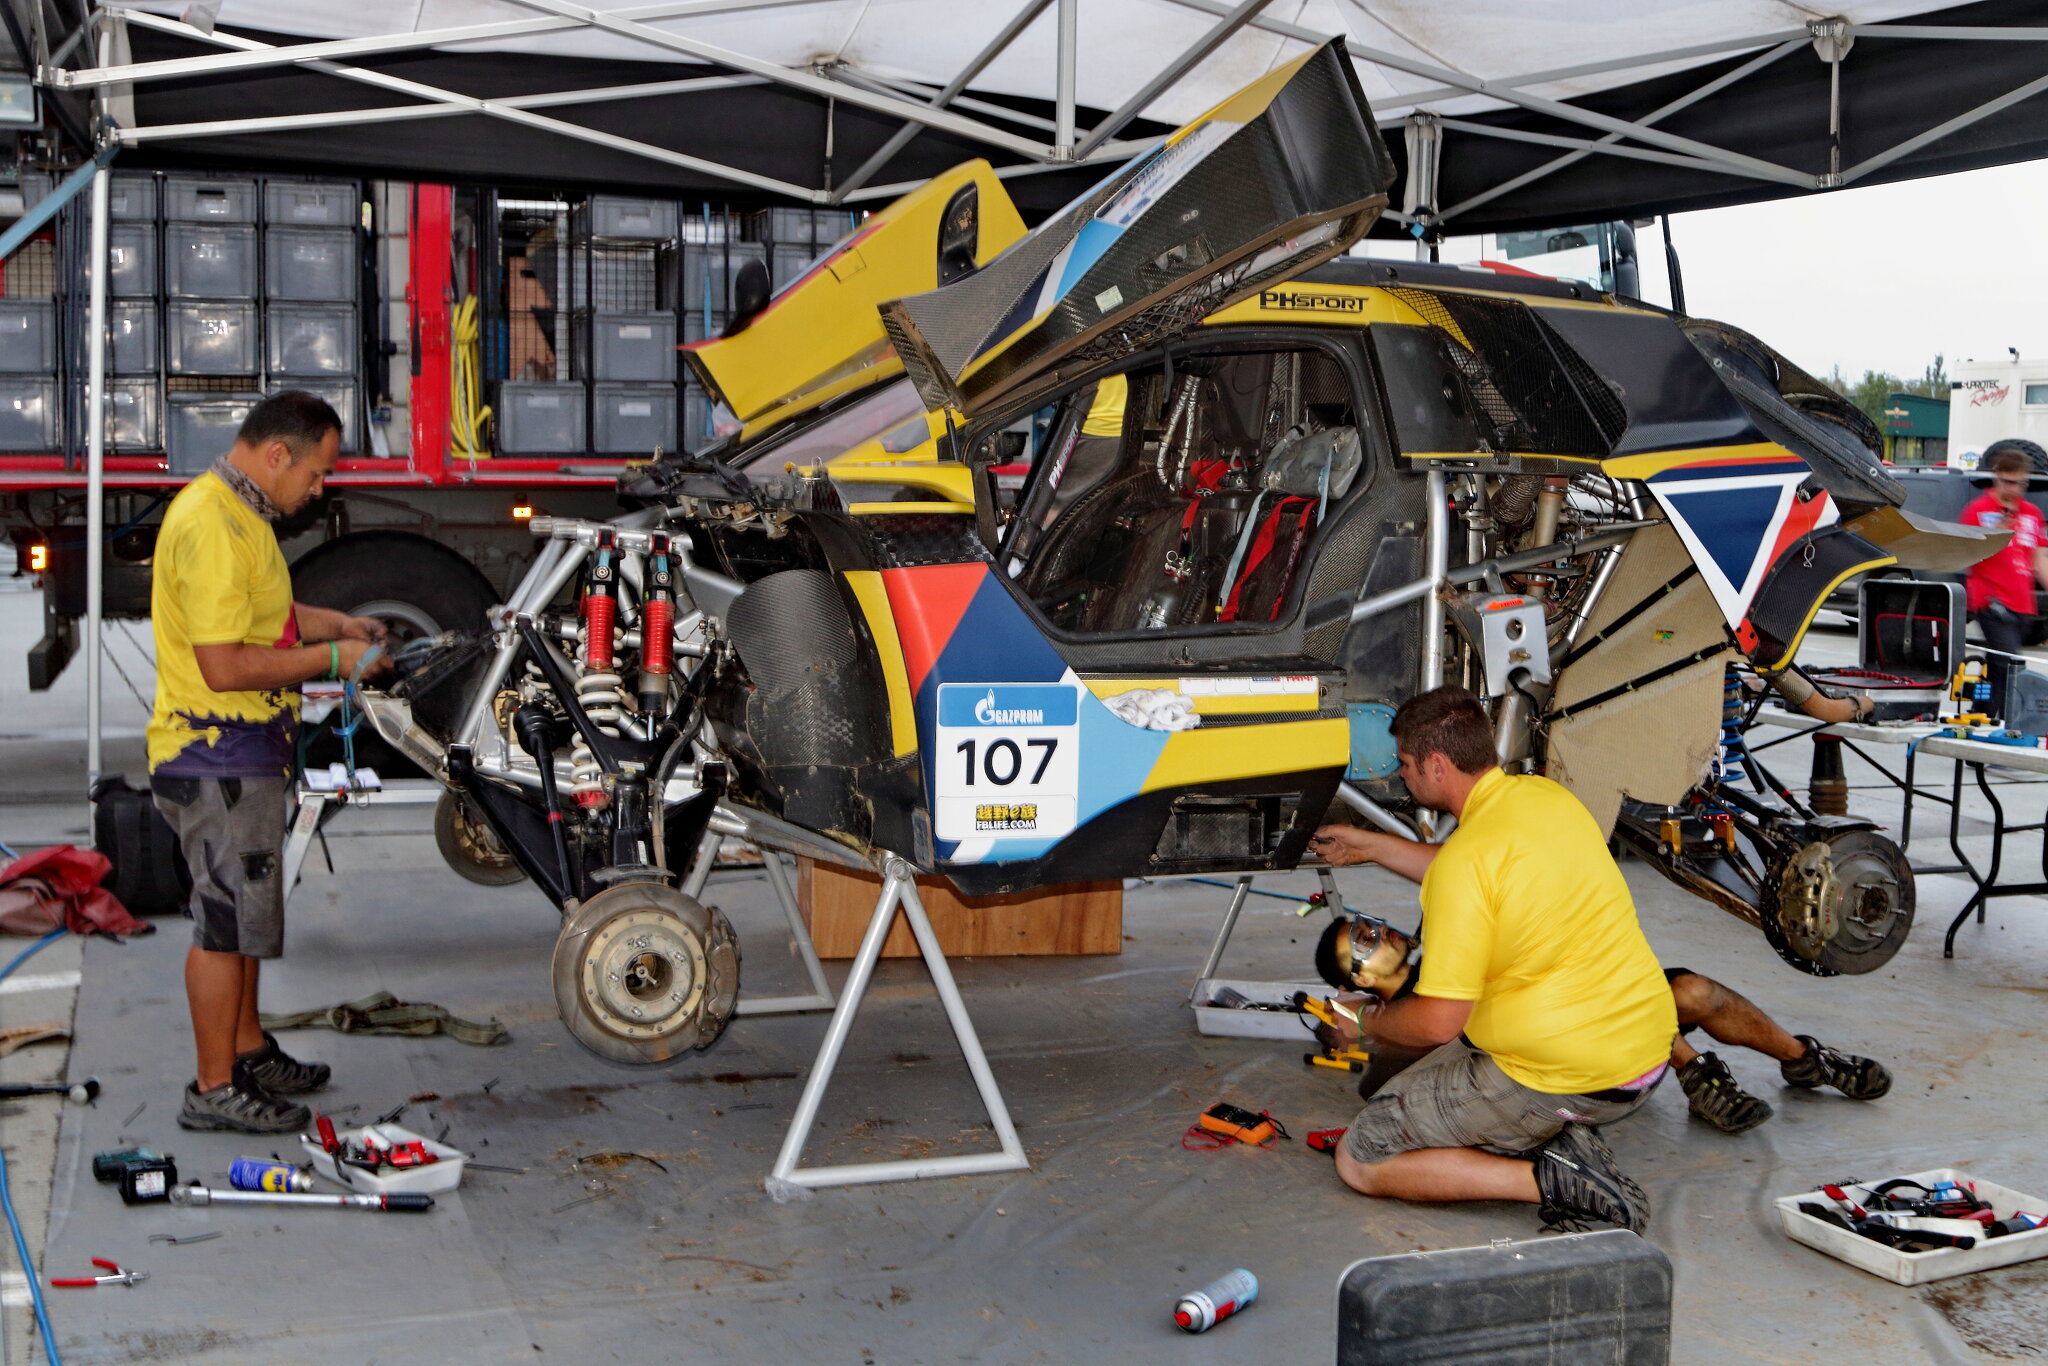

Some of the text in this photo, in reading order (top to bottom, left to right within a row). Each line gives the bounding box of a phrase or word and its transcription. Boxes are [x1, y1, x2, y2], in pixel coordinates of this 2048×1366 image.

[995, 710, 1043, 724] GAZPROM
[956, 737, 1058, 786] 107
[975, 820, 1037, 832] FBLIFE.COM
